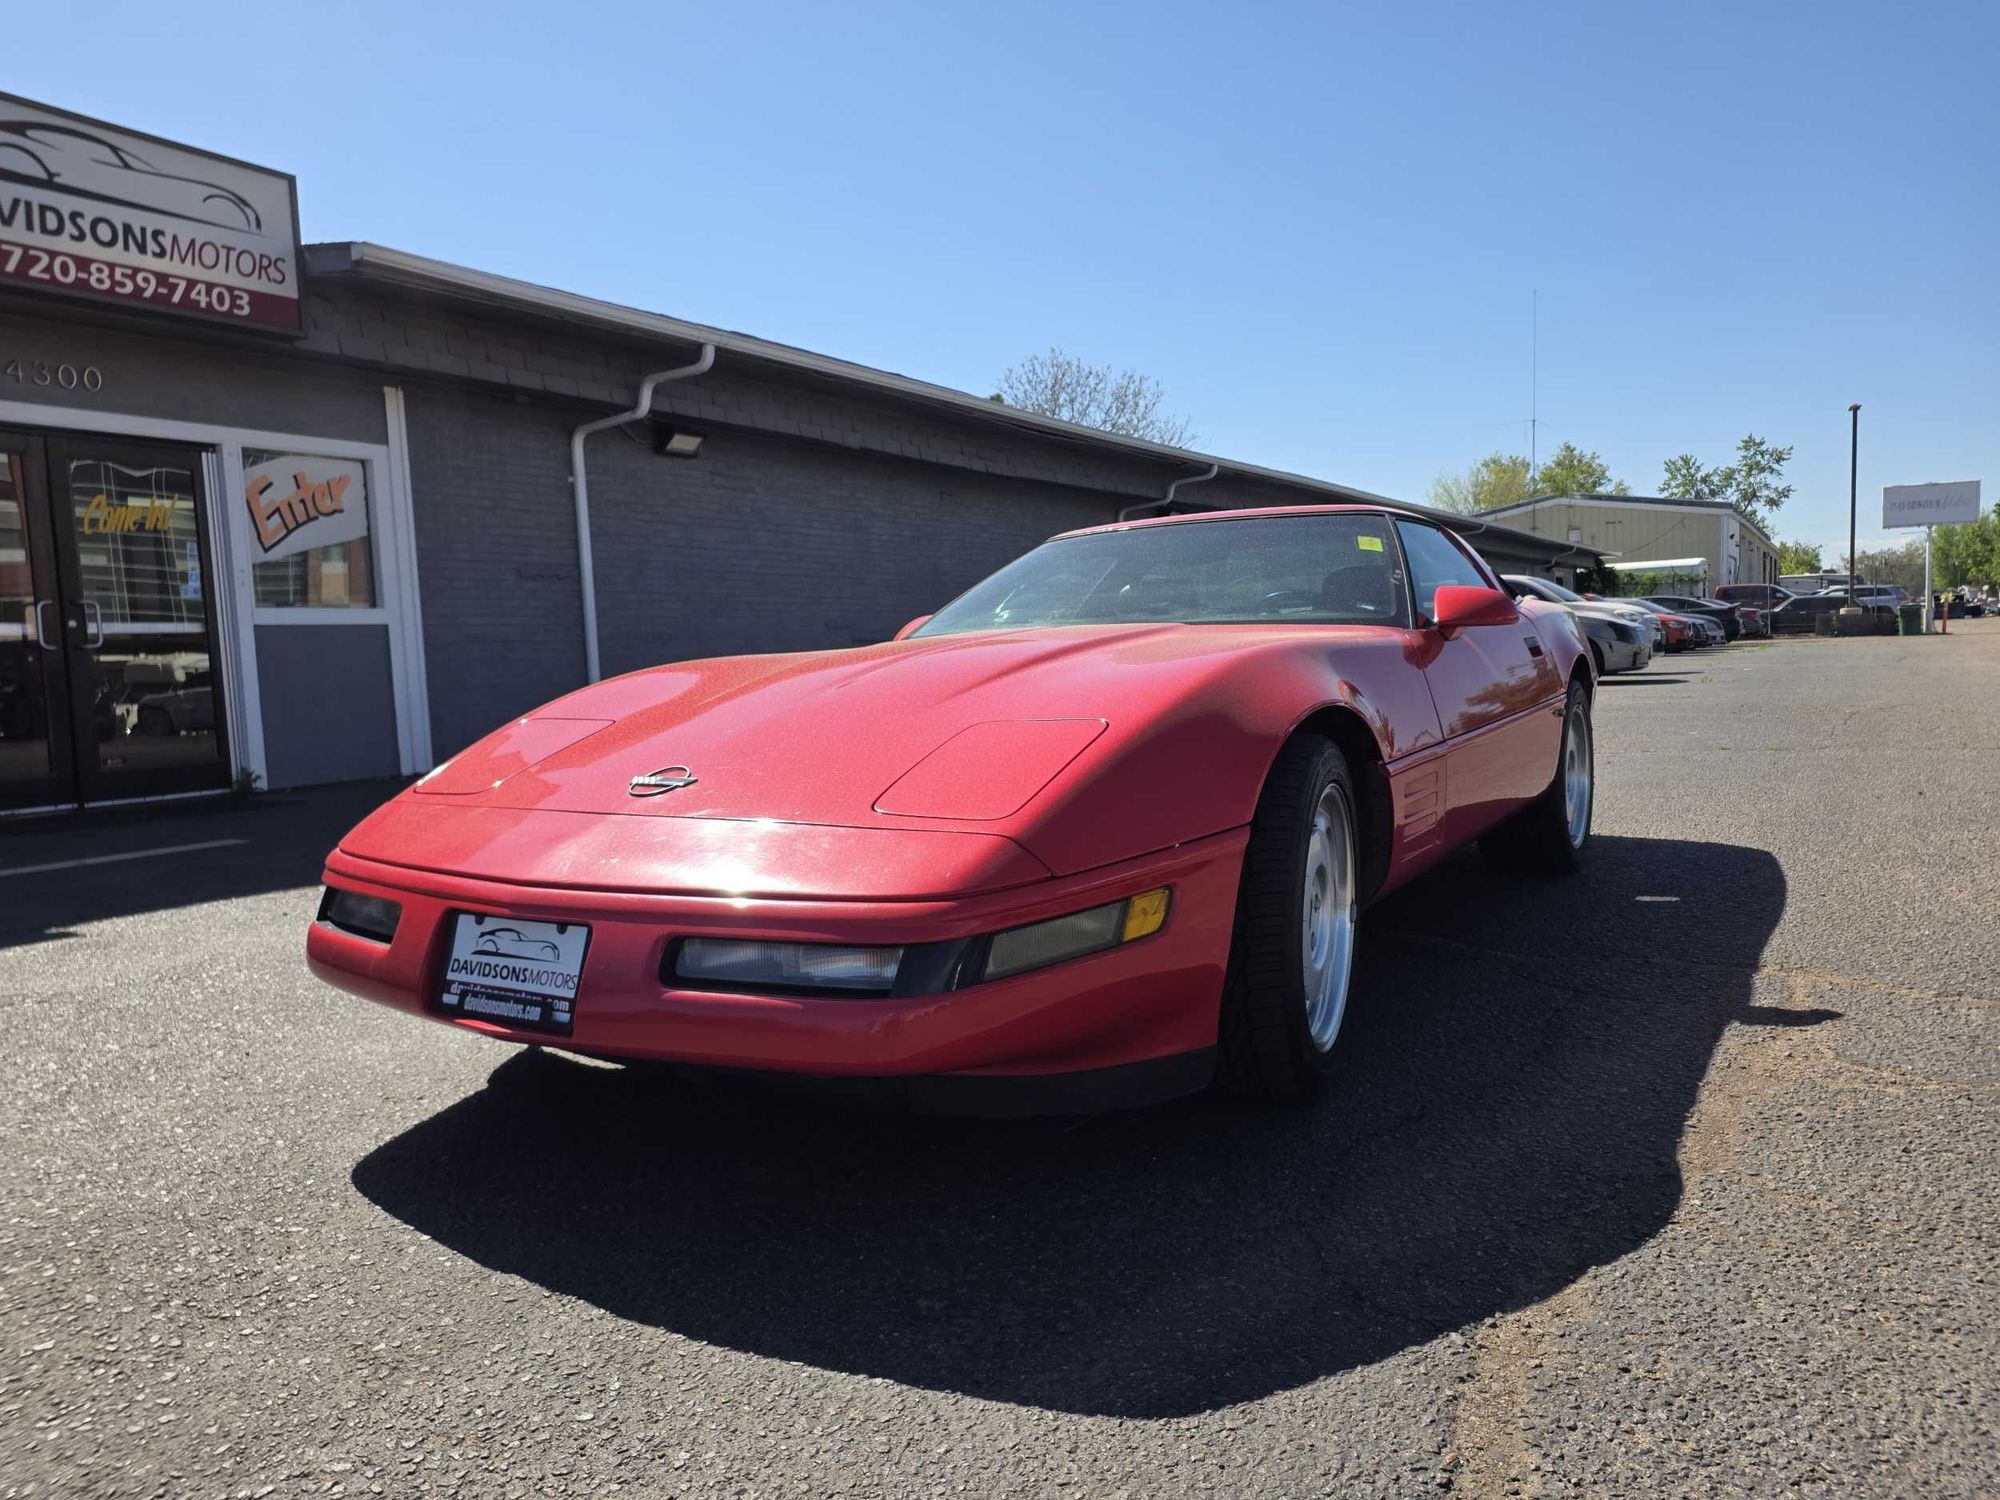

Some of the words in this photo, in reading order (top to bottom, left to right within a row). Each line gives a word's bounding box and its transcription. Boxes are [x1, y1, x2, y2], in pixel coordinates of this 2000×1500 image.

[0, 243, 251, 317] 720-859-7403
[6, 360, 102, 393] 4300
[245, 470, 352, 554] Enter
[450, 958, 578, 992] DAVIDSONSMOTORS
